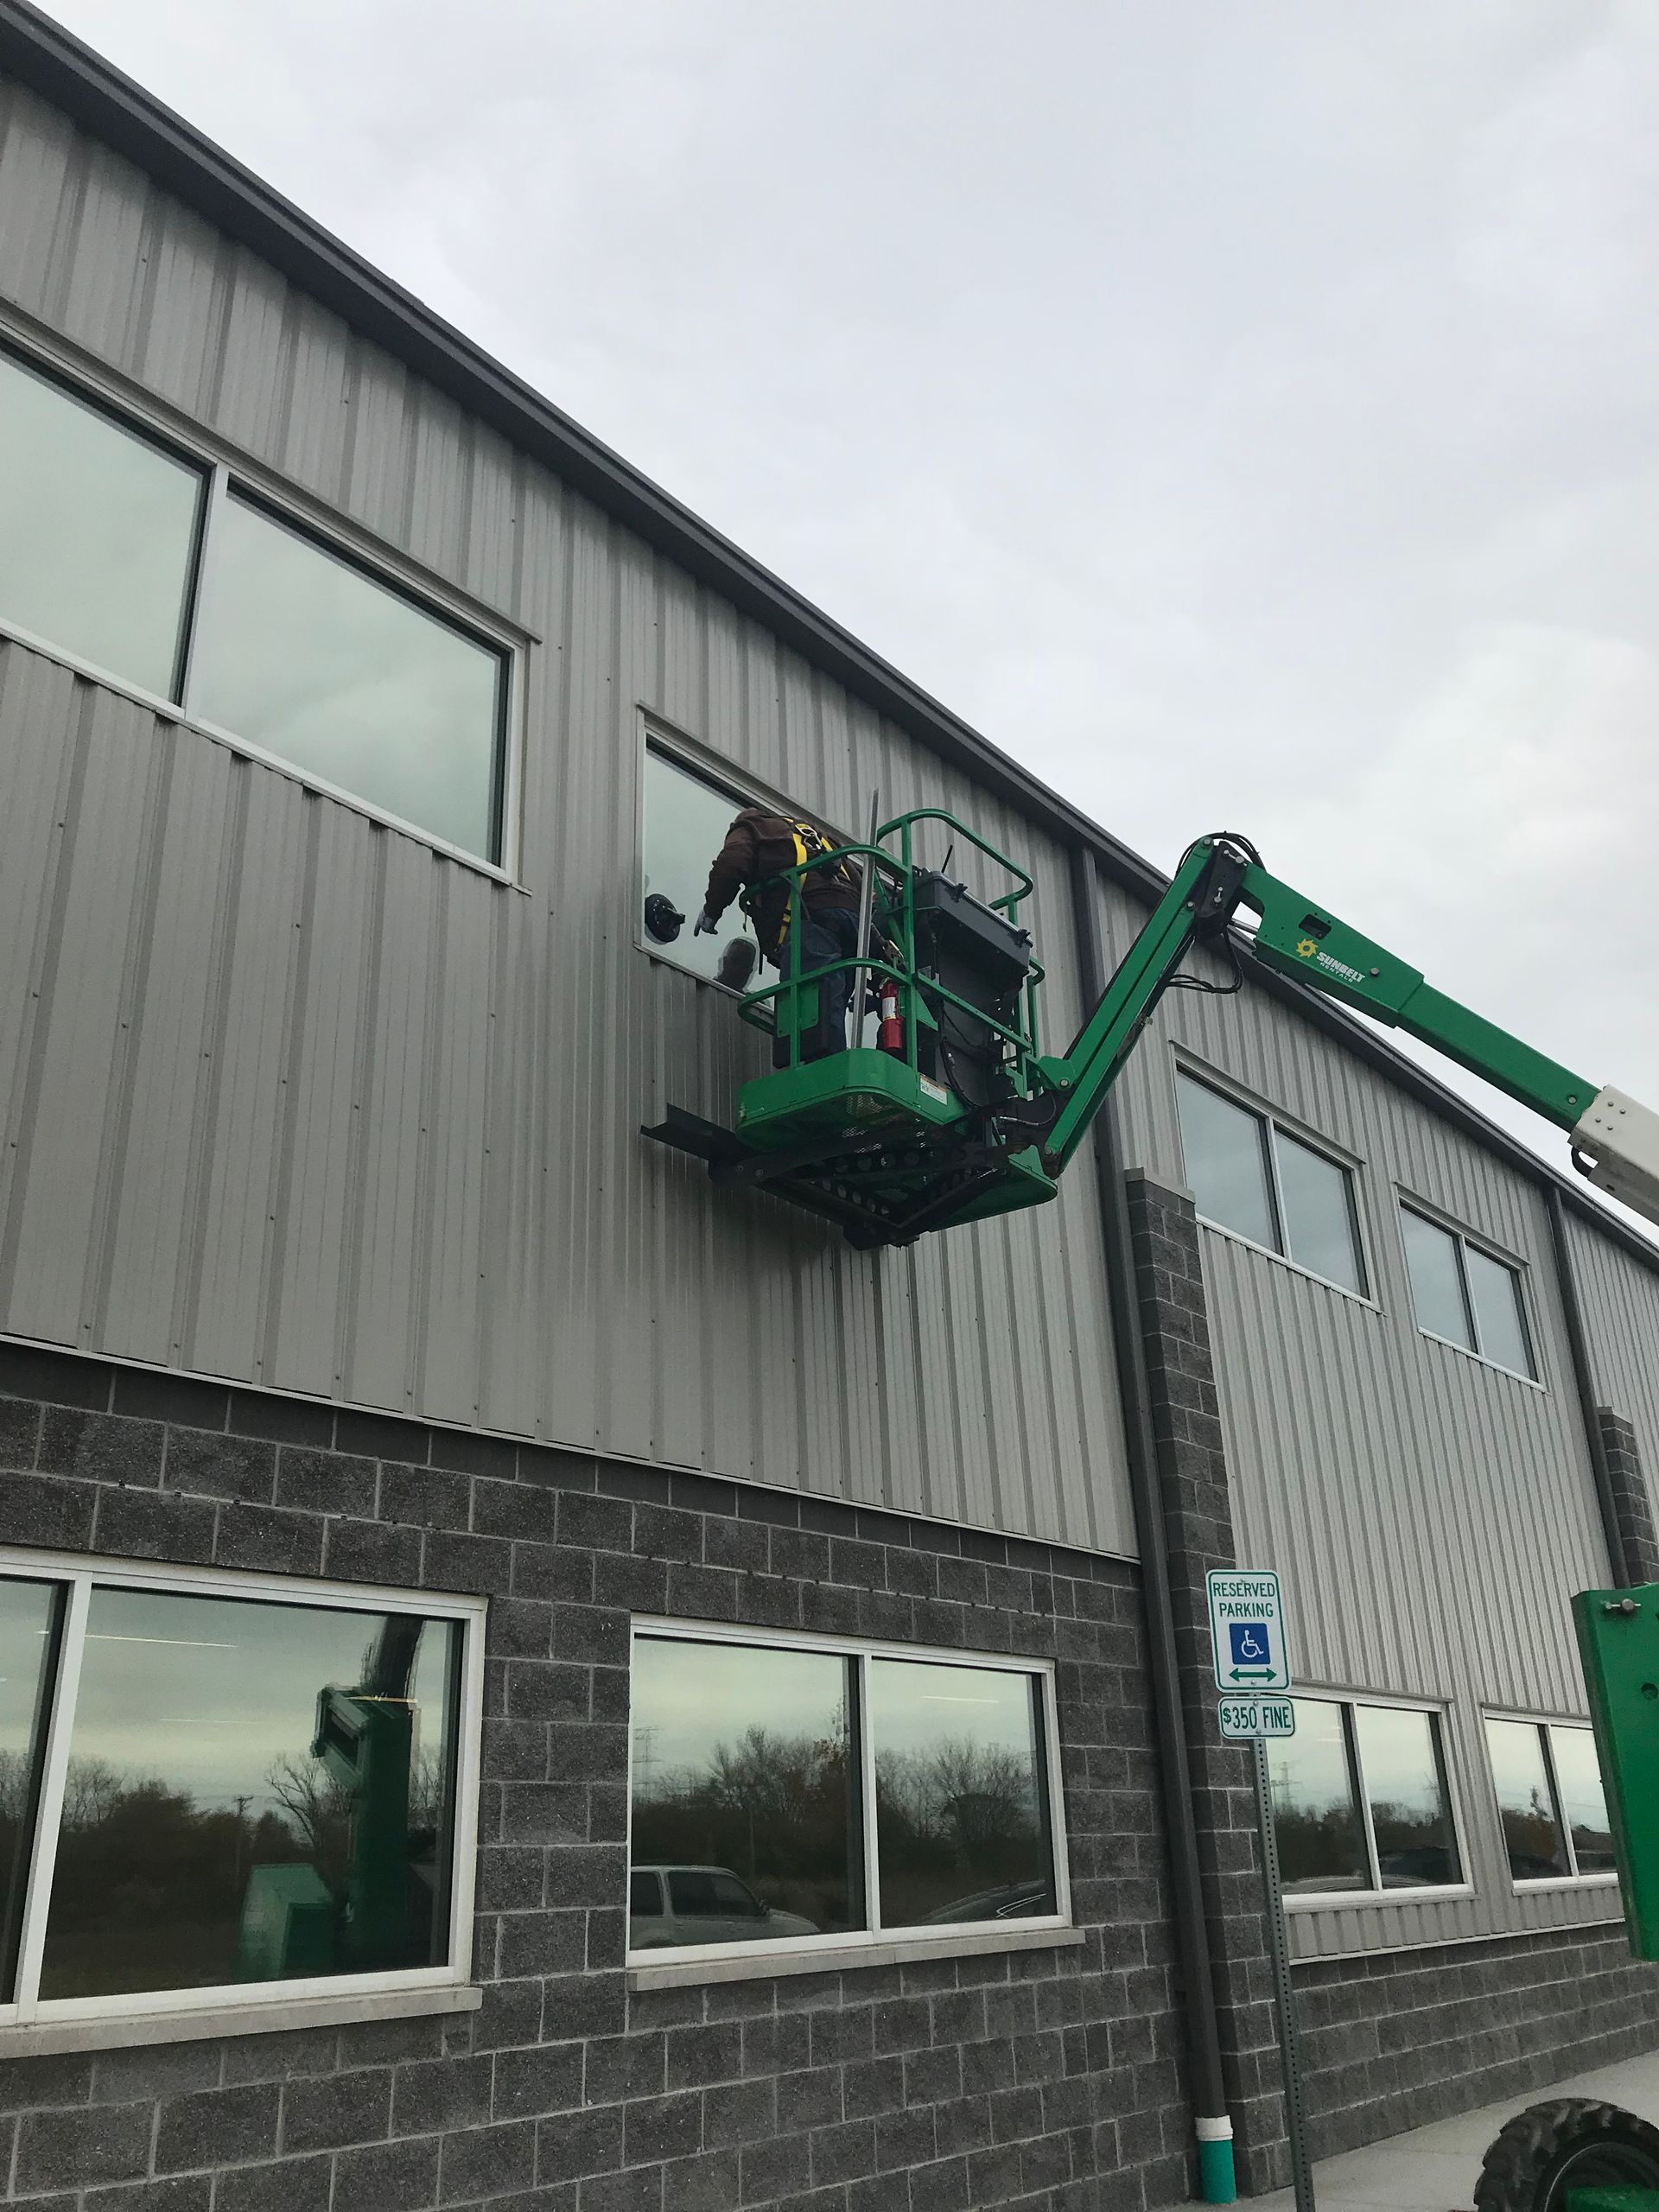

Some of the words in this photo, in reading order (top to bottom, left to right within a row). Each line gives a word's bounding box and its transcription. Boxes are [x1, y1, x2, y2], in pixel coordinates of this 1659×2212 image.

[1317, 951, 1365, 982] SUNBELT
[1213, 1582, 1275, 1597] RESERVED
[1219, 1603, 1274, 1618] PARKING
[1223, 1707, 1257, 1729] $350
[1262, 1707, 1291, 1728] FINE
